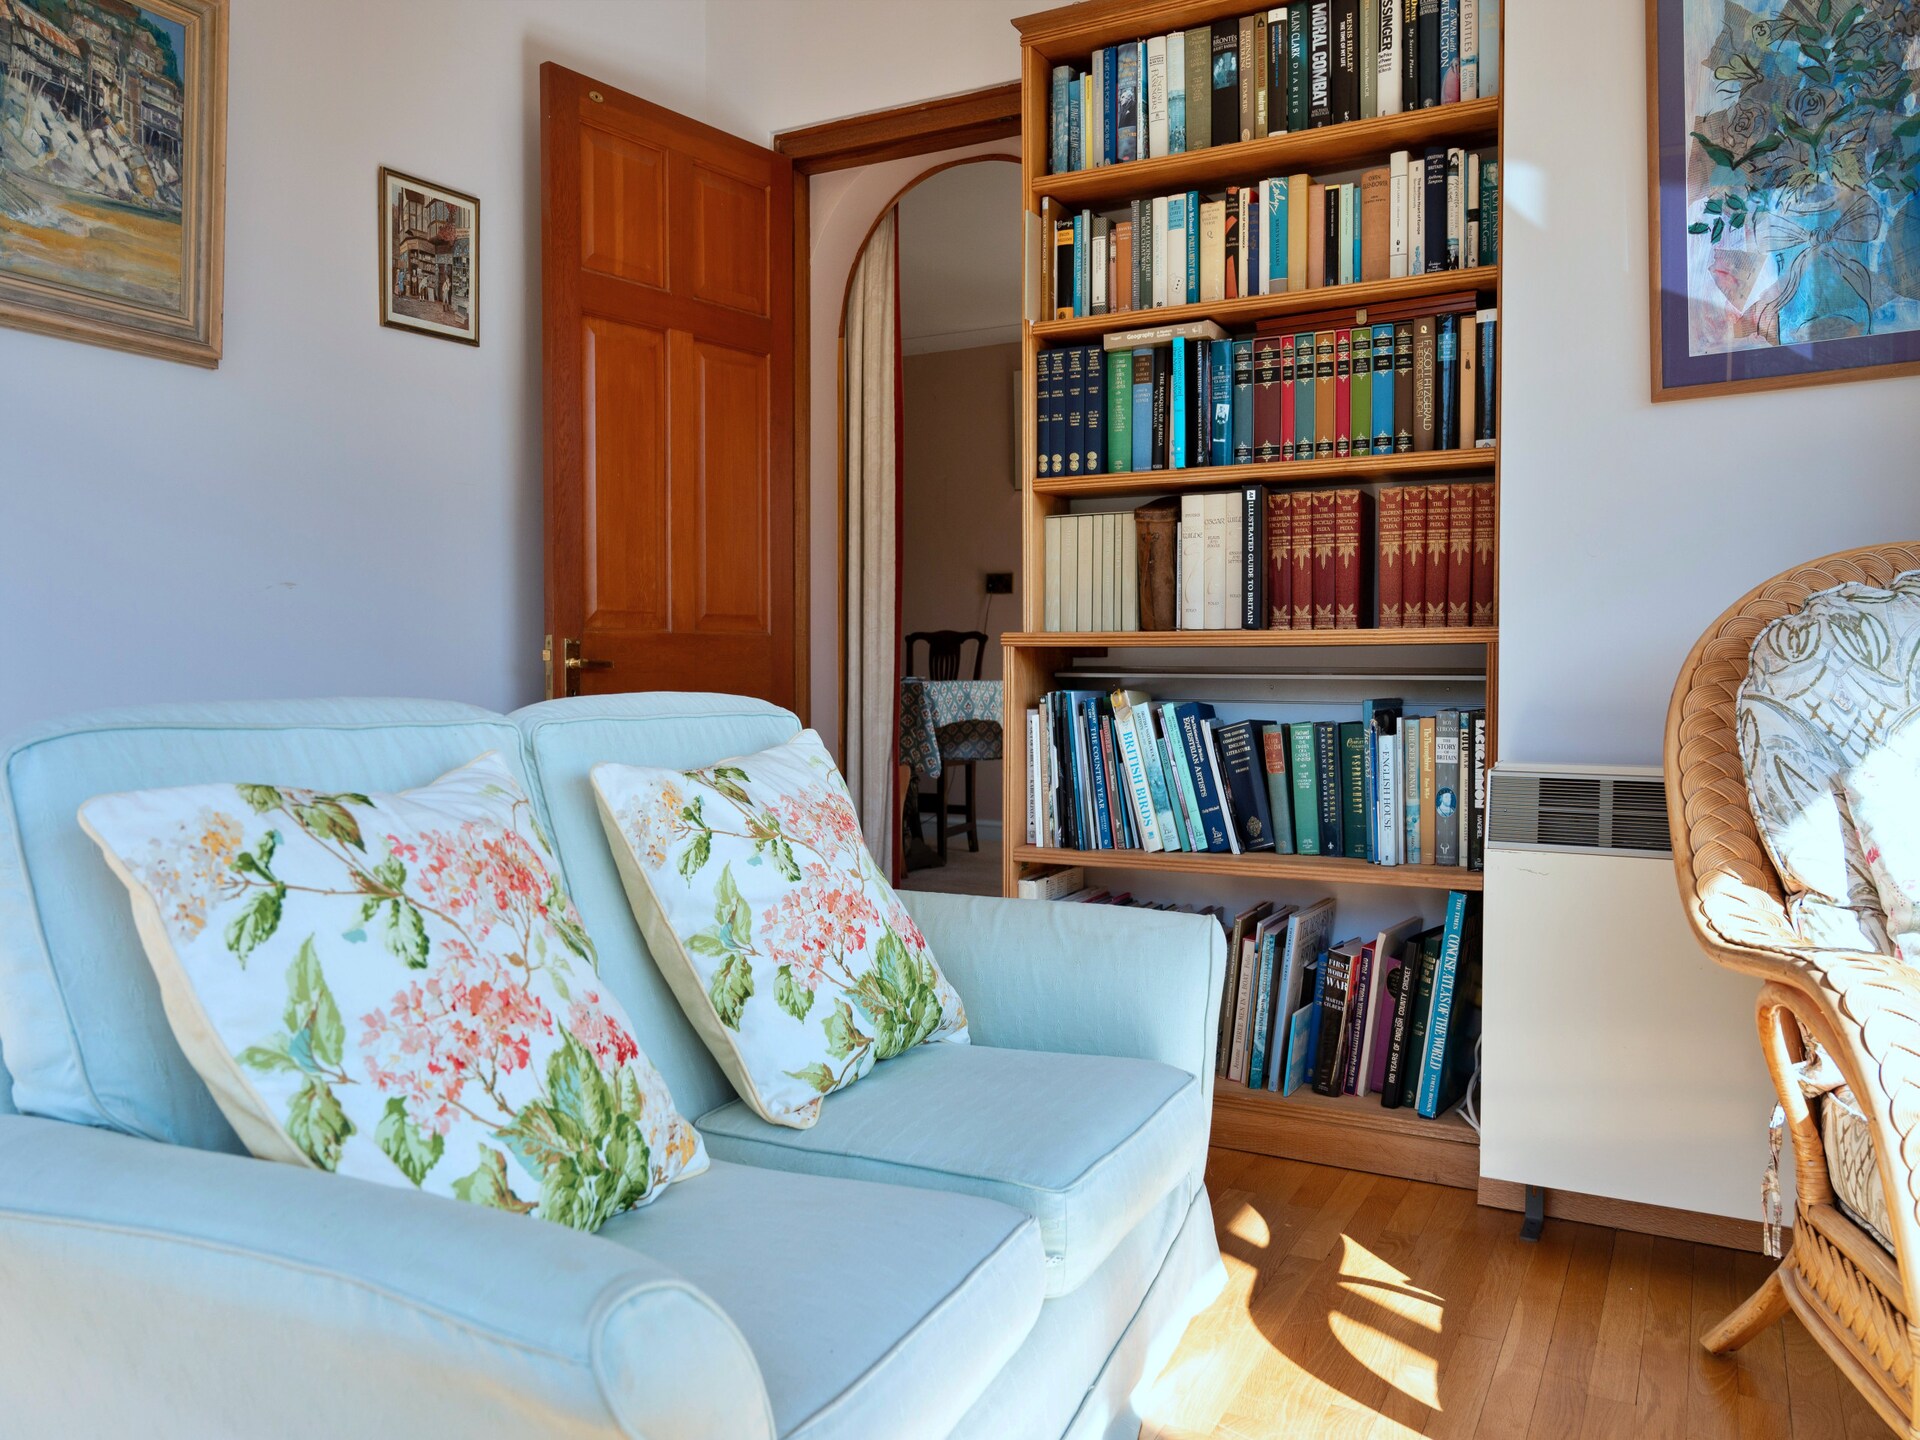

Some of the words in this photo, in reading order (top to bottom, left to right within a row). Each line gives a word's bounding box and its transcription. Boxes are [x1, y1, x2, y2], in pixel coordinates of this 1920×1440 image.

[1291, 11, 1300, 32] ALAN
[1450, 8, 1458, 17] To
[1312, 3, 1327, 51] MORAL
[1408, 28, 1415, 38] My
[1464, 12, 1472, 53] BATTLES
[1291, 33, 1300, 59] CLARK
[1312, 51, 1327, 106] COMBAT
[1145, 225, 1151, 236] AM
[1206, 230, 1214, 239] Q
[1126, 331, 1155, 341] Geography
[1423, 347, 1432, 377] SCOTT
[1423, 378, 1432, 430] FITZGERALD
[1159, 414, 1165, 422] OF
[1247, 579, 1254, 591] TO
[1363, 729, 1371, 746] The
[1408, 729, 1416, 745] THE
[1423, 727, 1432, 738] The
[1183, 716, 1199, 764] EQUESTRIAN
[1195, 767, 1208, 798] ARTISTS
[1326, 727, 1335, 778] BERTRAND
[1408, 745, 1416, 761] CREE
[1422, 738, 1432, 772] Thoroughbred
[1382, 751, 1391, 796] ENGLISH
[1474, 719, 1485, 808] BACKGAMMON
[1092, 745, 1102, 785] COUNTRY
[1097, 787, 1105, 809] YEAR
[1123, 731, 1143, 785] BRITISH
[1136, 787, 1153, 827] BIRDS
[1408, 761, 1416, 797] JOURNALS
[1328, 783, 1336, 823] RUSSELL
[1382, 797, 1391, 831] HOUSE
[1453, 911, 1461, 929] TIMES
[1243, 954, 1251, 969] Folio
[1444, 933, 1460, 972] CONCISE
[1327, 967, 1350, 979] WORLD
[1328, 958, 1350, 971] FIRST
[1361, 957, 1369, 974] FOLIO
[1241, 972, 1249, 990] BOAT
[1326, 976, 1348, 991] WAR
[1401, 966, 1411, 990] CRICKET
[1440, 972, 1454, 1003] ATLAS
[1239, 998, 1246, 1006] IN
[1325, 996, 1344, 1006] MARTIN
[1358, 982, 1366, 1002] WORLD
[1324, 1002, 1344, 1012] GILBERT
[1398, 992, 1407, 1016] COUNTY
[1438, 1003, 1450, 1014] OF
[1235, 1023, 1244, 1044] THREE
[1394, 1018, 1404, 1042] ENGLISH
[1434, 1015, 1447, 1035] THE
[1393, 1042, 1400, 1051] OF
[1430, 1035, 1445, 1070] WORLD
[1233, 1048, 1241, 1069] Jerome
[1389, 1052, 1399, 1072] YEARS
[1388, 1073, 1396, 1083] 100
